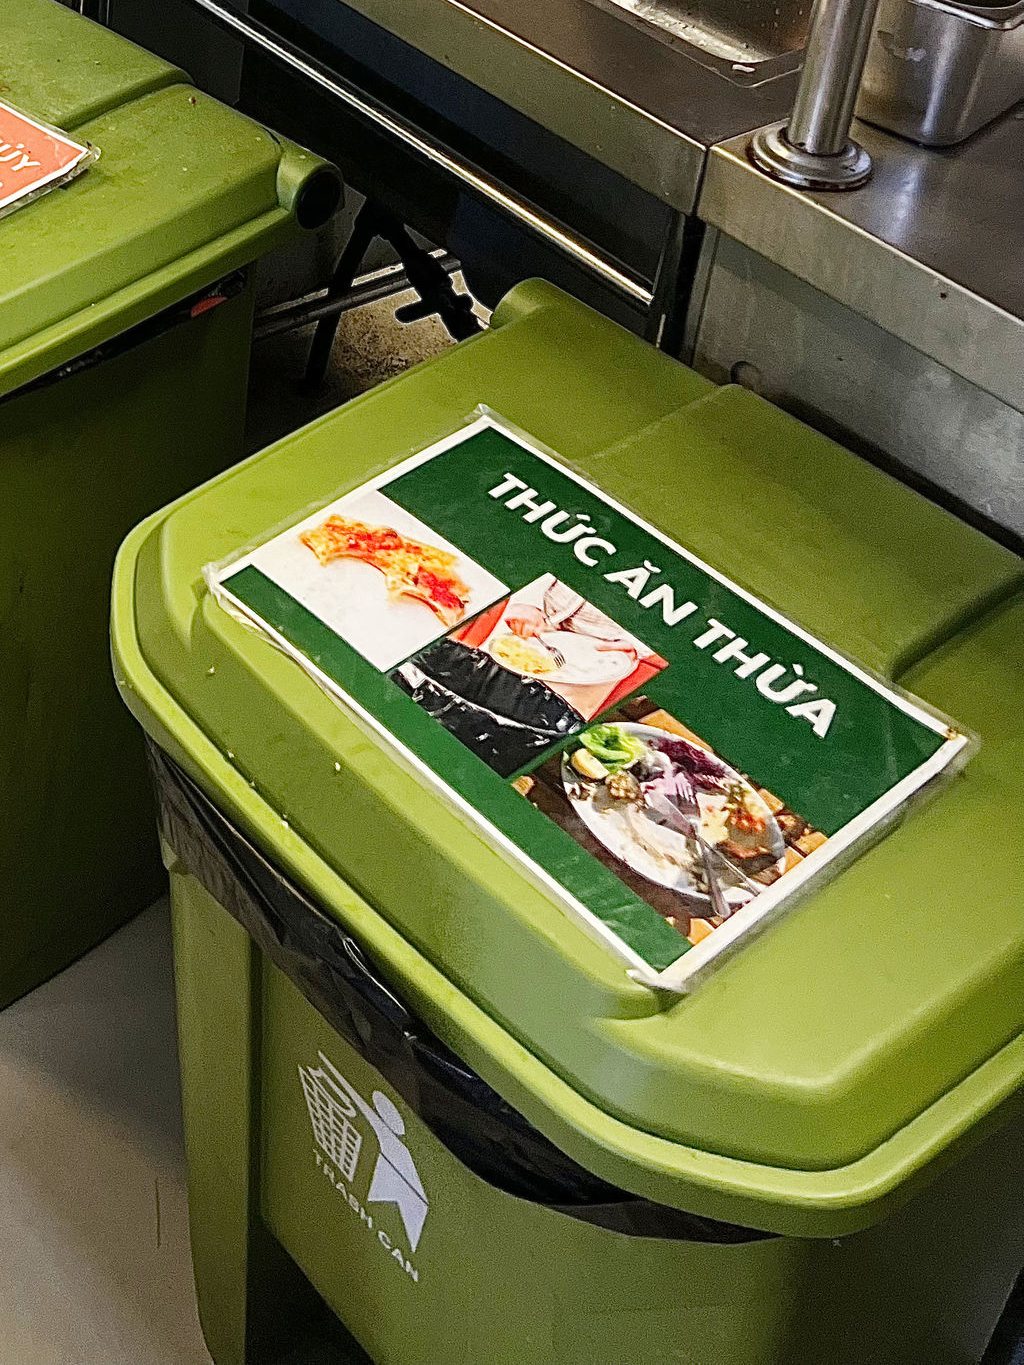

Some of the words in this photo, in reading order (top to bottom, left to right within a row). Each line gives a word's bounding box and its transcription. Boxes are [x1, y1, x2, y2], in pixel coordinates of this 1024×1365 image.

[487, 472, 617, 568] THỨC
[603, 559, 698, 627] ĂN
[692, 618, 838, 739] THỪA
[313, 1148, 373, 1230] TRASH
[378, 1230, 419, 1283] CAN
